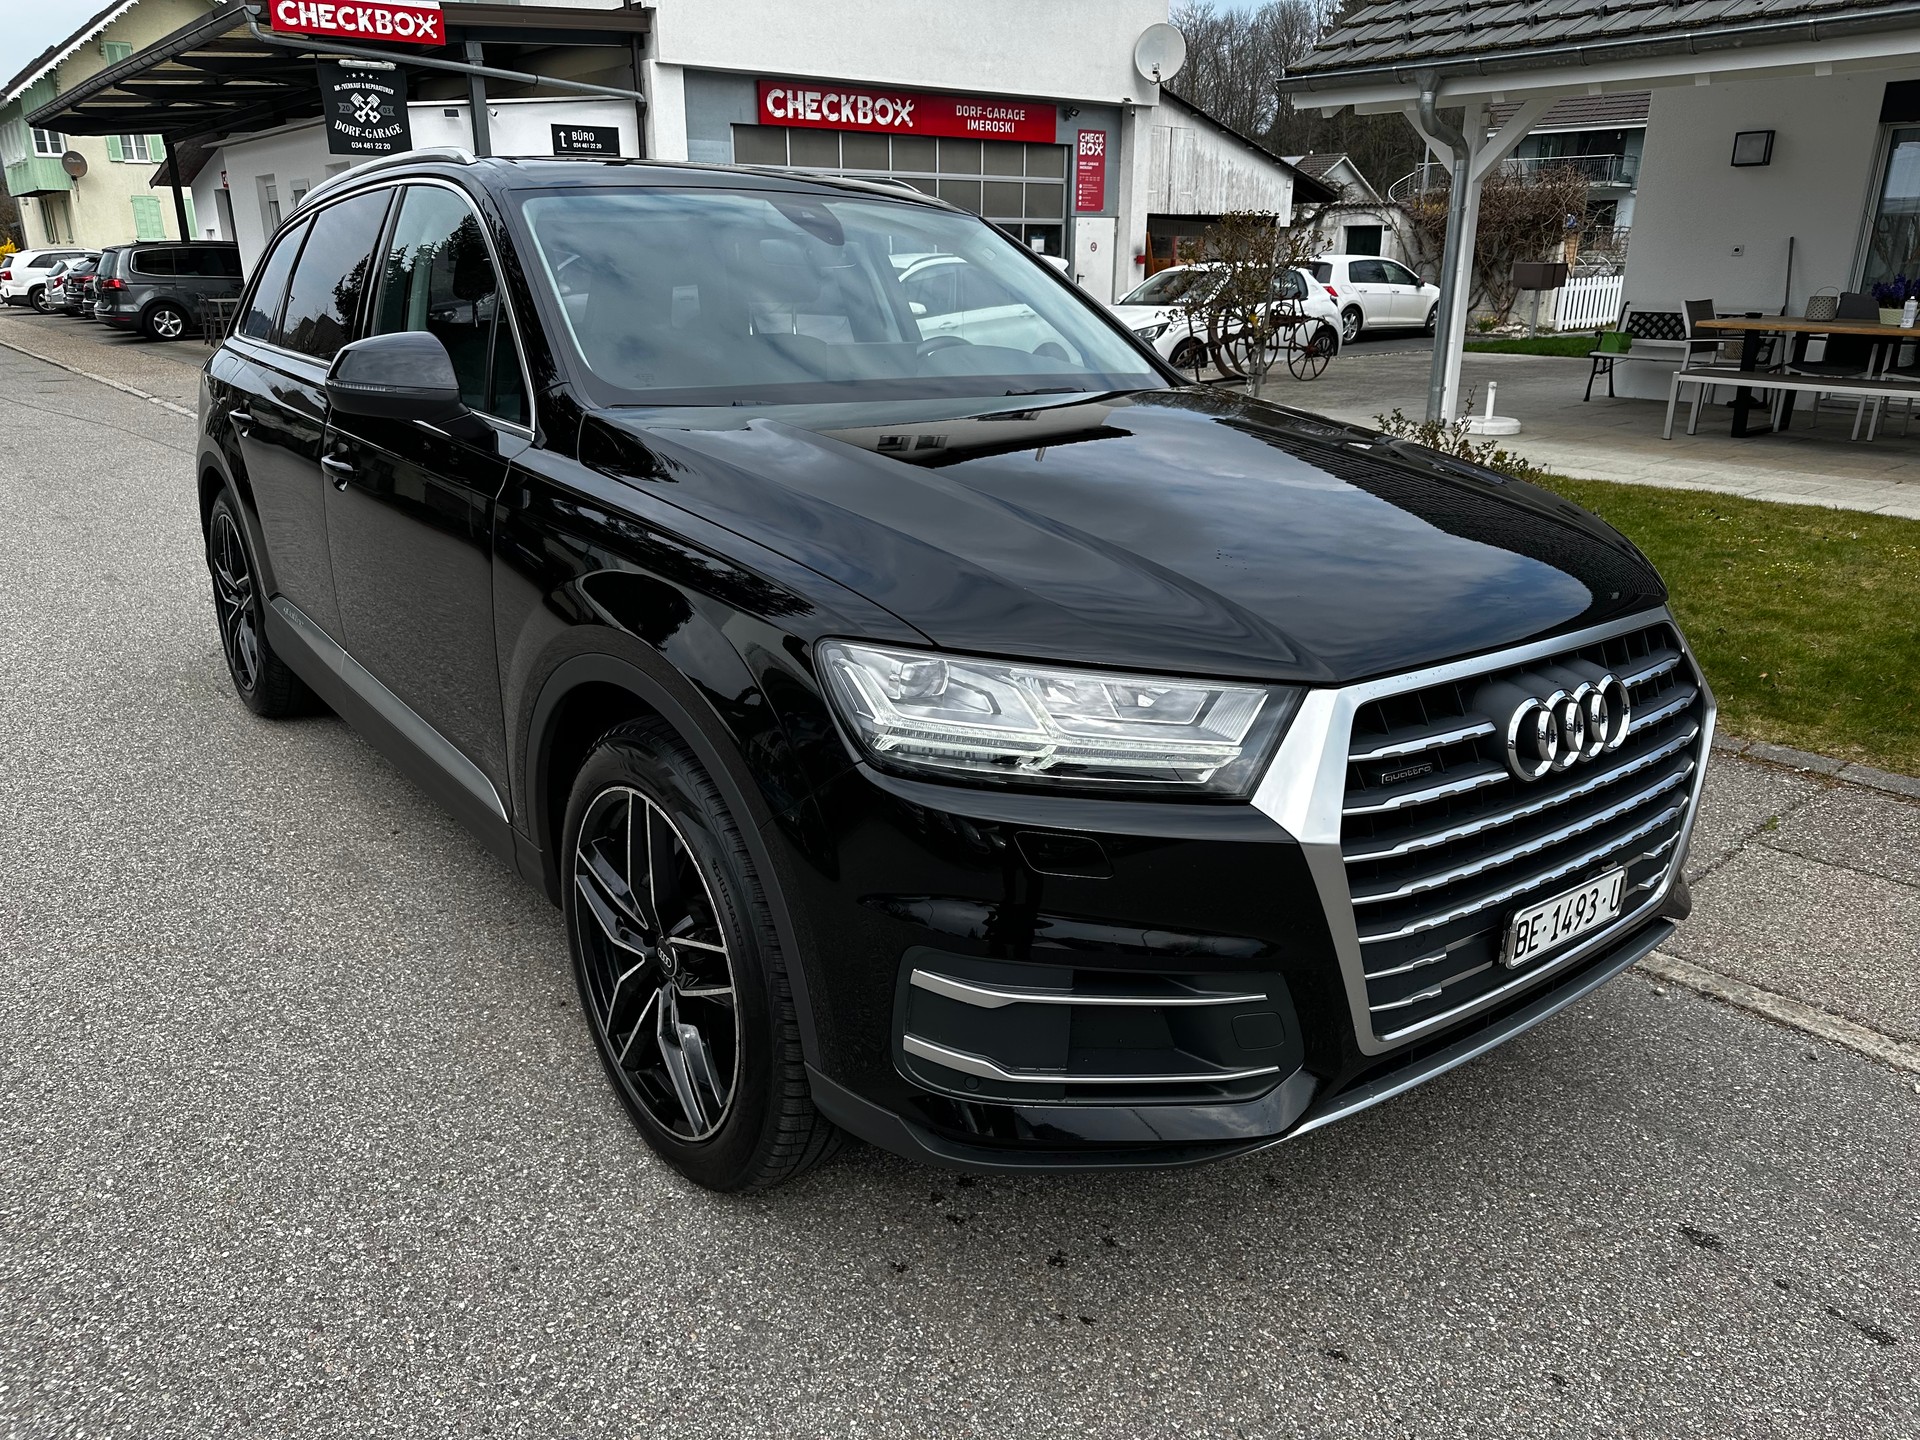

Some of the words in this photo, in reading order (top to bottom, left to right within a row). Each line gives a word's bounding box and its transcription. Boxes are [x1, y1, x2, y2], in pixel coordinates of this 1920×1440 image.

[276, 0, 438, 39] CHECKBOX
[341, 104, 351, 112] 20
[382, 107, 391, 115] 03
[766, 88, 915, 128] CHECKBOX
[956, 104, 1026, 121] DORF-GARAGE
[334, 119, 403, 139] DORF-GARAGE
[967, 118, 1015, 133] IMEROSKI
[571, 129, 595, 142] BÜRO
[1080, 133, 1104, 143] CHECK
[351, 141, 362, 149] 034
[375, 142, 383, 150] 22
[1080, 142, 1104, 156] BOX
[1385, 765, 1431, 782] quattro
